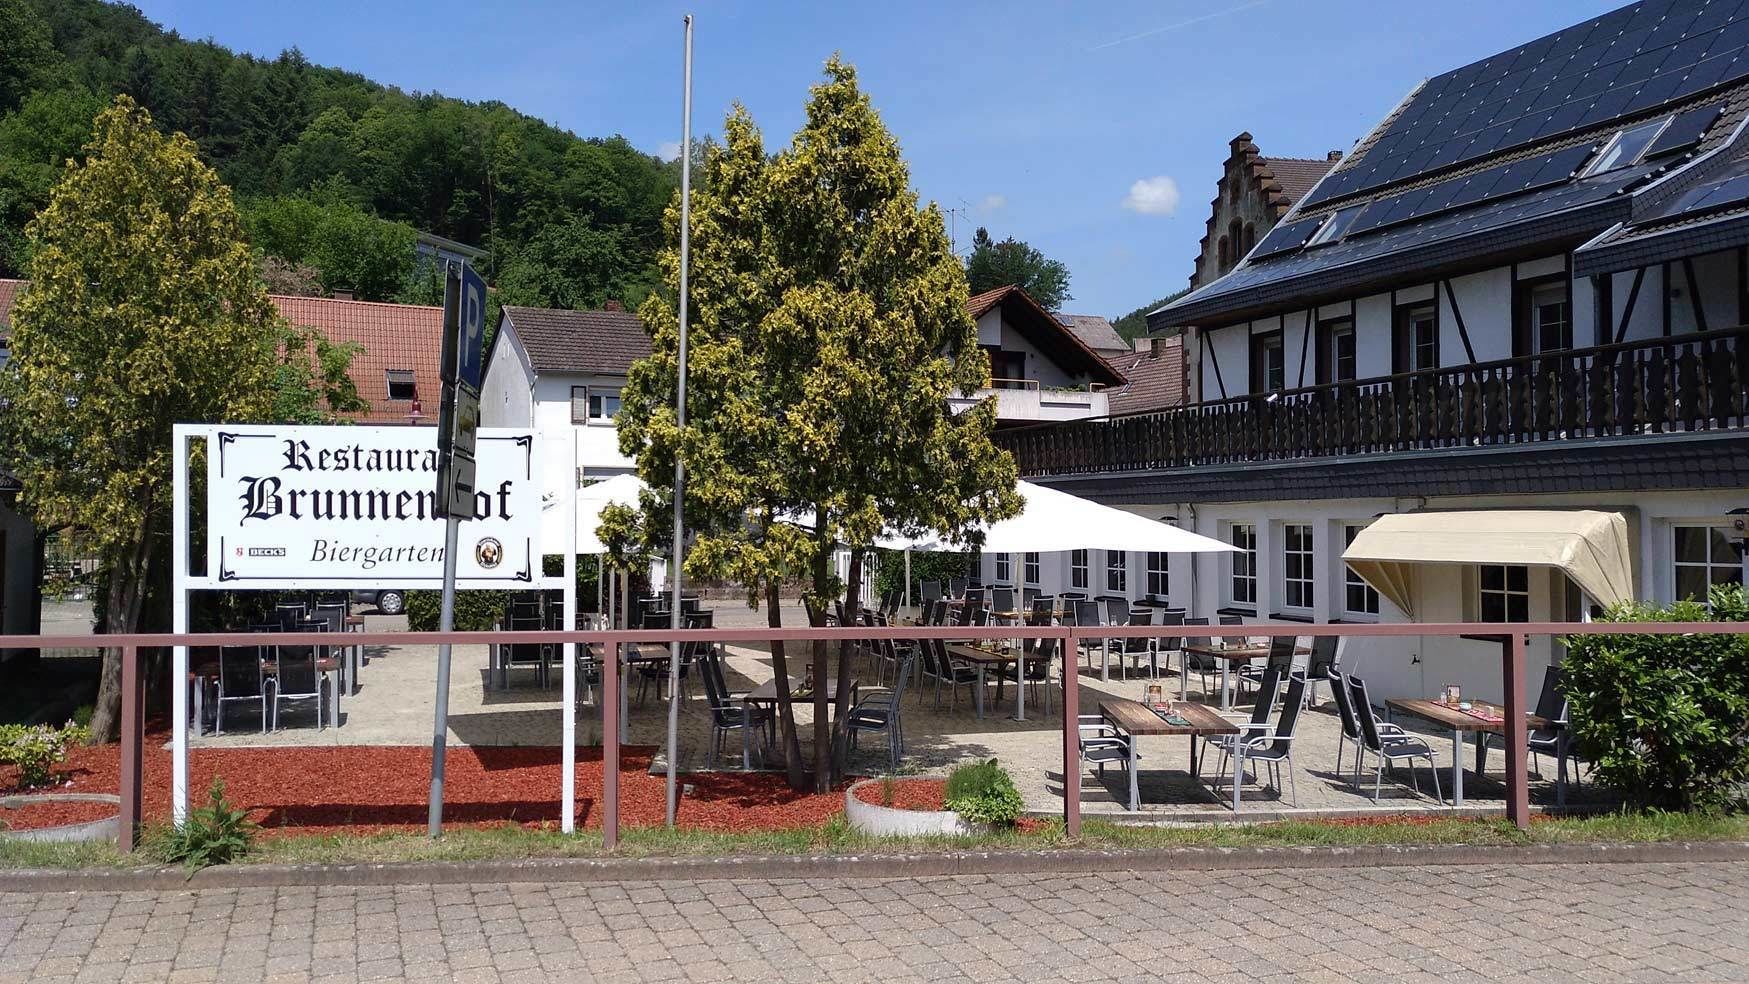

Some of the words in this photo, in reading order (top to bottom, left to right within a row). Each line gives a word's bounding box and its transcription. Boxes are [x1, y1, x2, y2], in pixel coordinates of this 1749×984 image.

[464, 282, 479, 367] P
[281, 439, 438, 473] Restaura
[238, 477, 513, 526] Brunnenof
[310, 539, 445, 569] Biergarten
